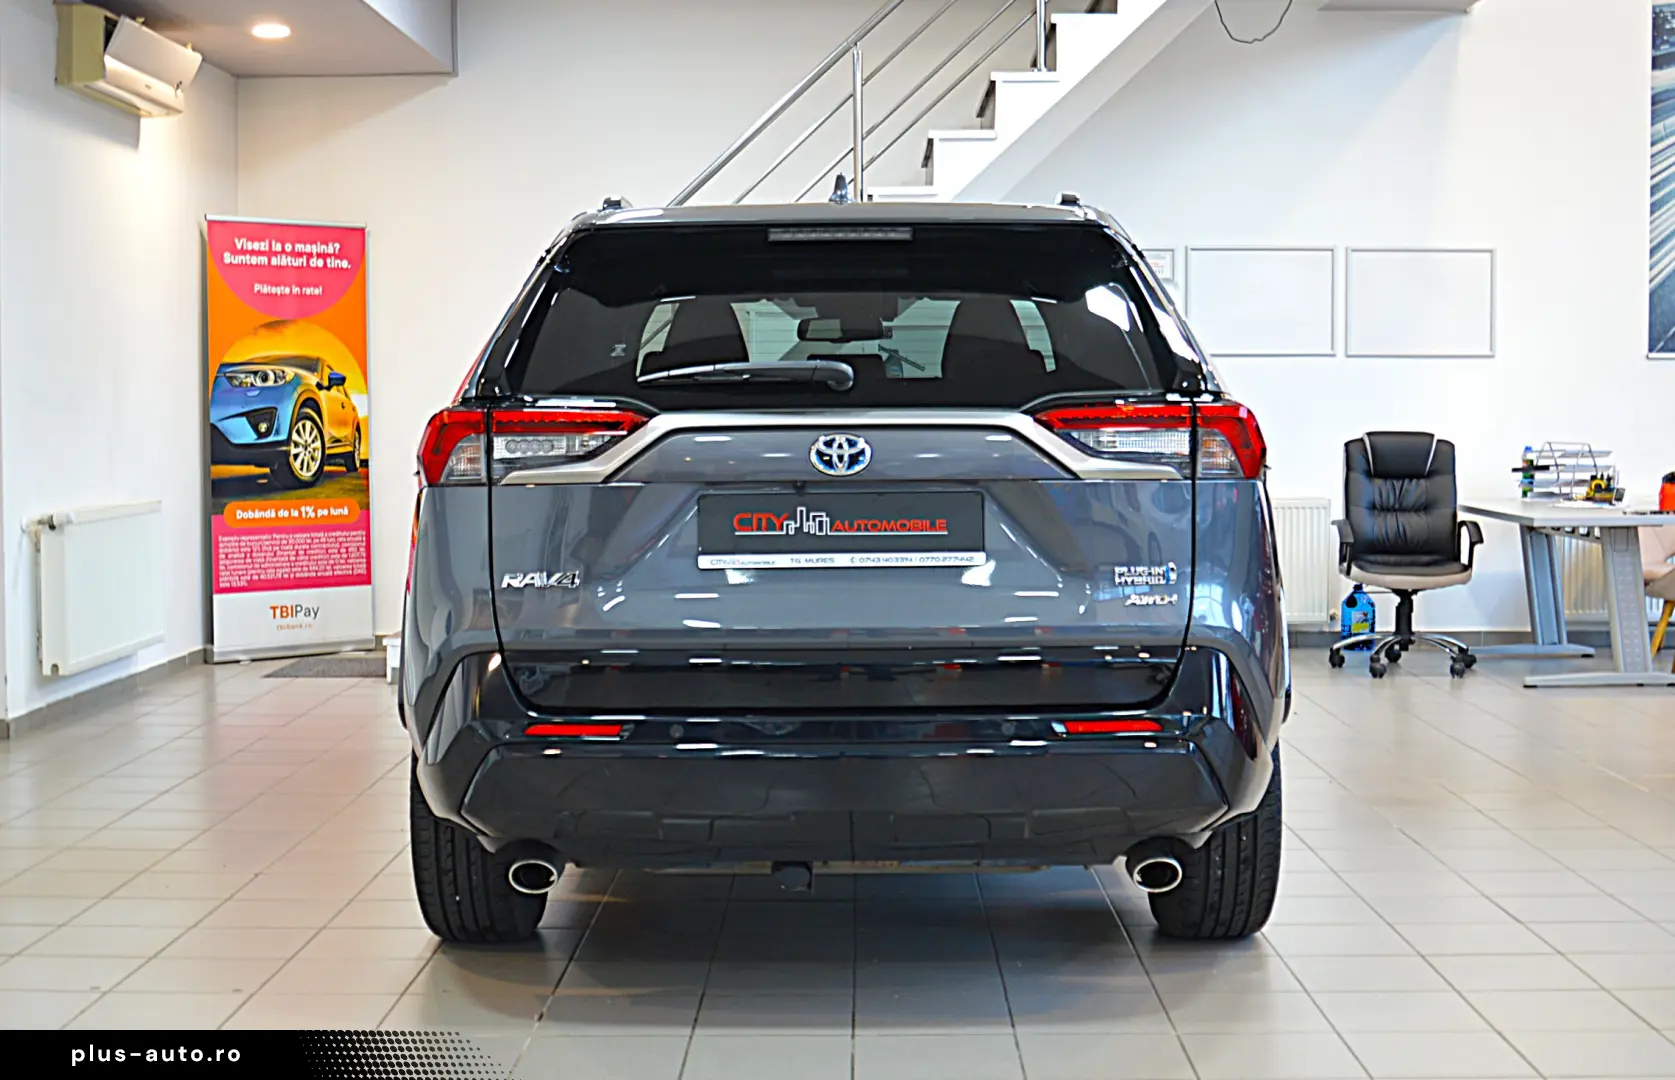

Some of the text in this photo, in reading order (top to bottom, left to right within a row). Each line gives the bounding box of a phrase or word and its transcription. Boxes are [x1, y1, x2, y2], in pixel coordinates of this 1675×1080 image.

[234, 237, 269, 251] Visezi
[271, 239, 282, 252] la
[284, 243, 293, 253] o
[223, 252, 268, 266] Suntem
[309, 255, 324, 268] de
[302, 285, 323, 296] rate!
[278, 507, 289, 518] de
[291, 507, 299, 518] la
[300, 505, 316, 519] 1%
[317, 508, 329, 519] pe
[733, 512, 948, 533] CITY AUTOMOBILE
[501, 570, 580, 589] RAV4
